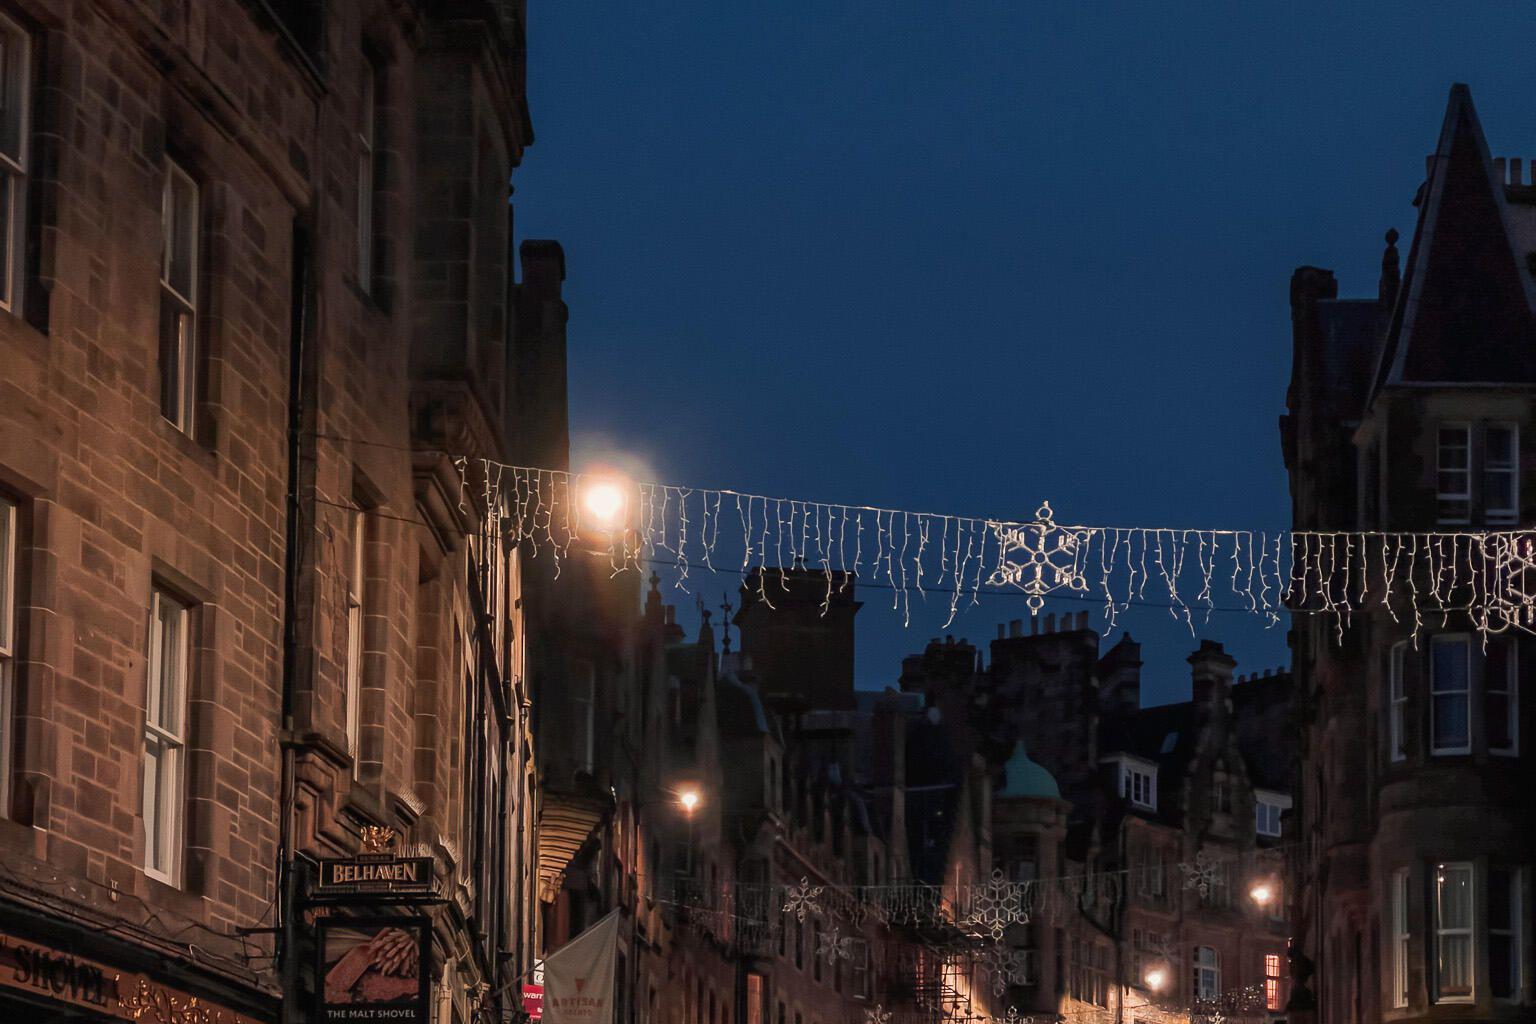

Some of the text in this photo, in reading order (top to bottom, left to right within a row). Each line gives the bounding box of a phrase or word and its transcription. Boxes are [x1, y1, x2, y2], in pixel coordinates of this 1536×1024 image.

[333, 862, 417, 884] BELHAVEN
[13, 944, 108, 1007] SHOVEL
[327, 1008, 417, 1019] THE MALT SHOVEL
